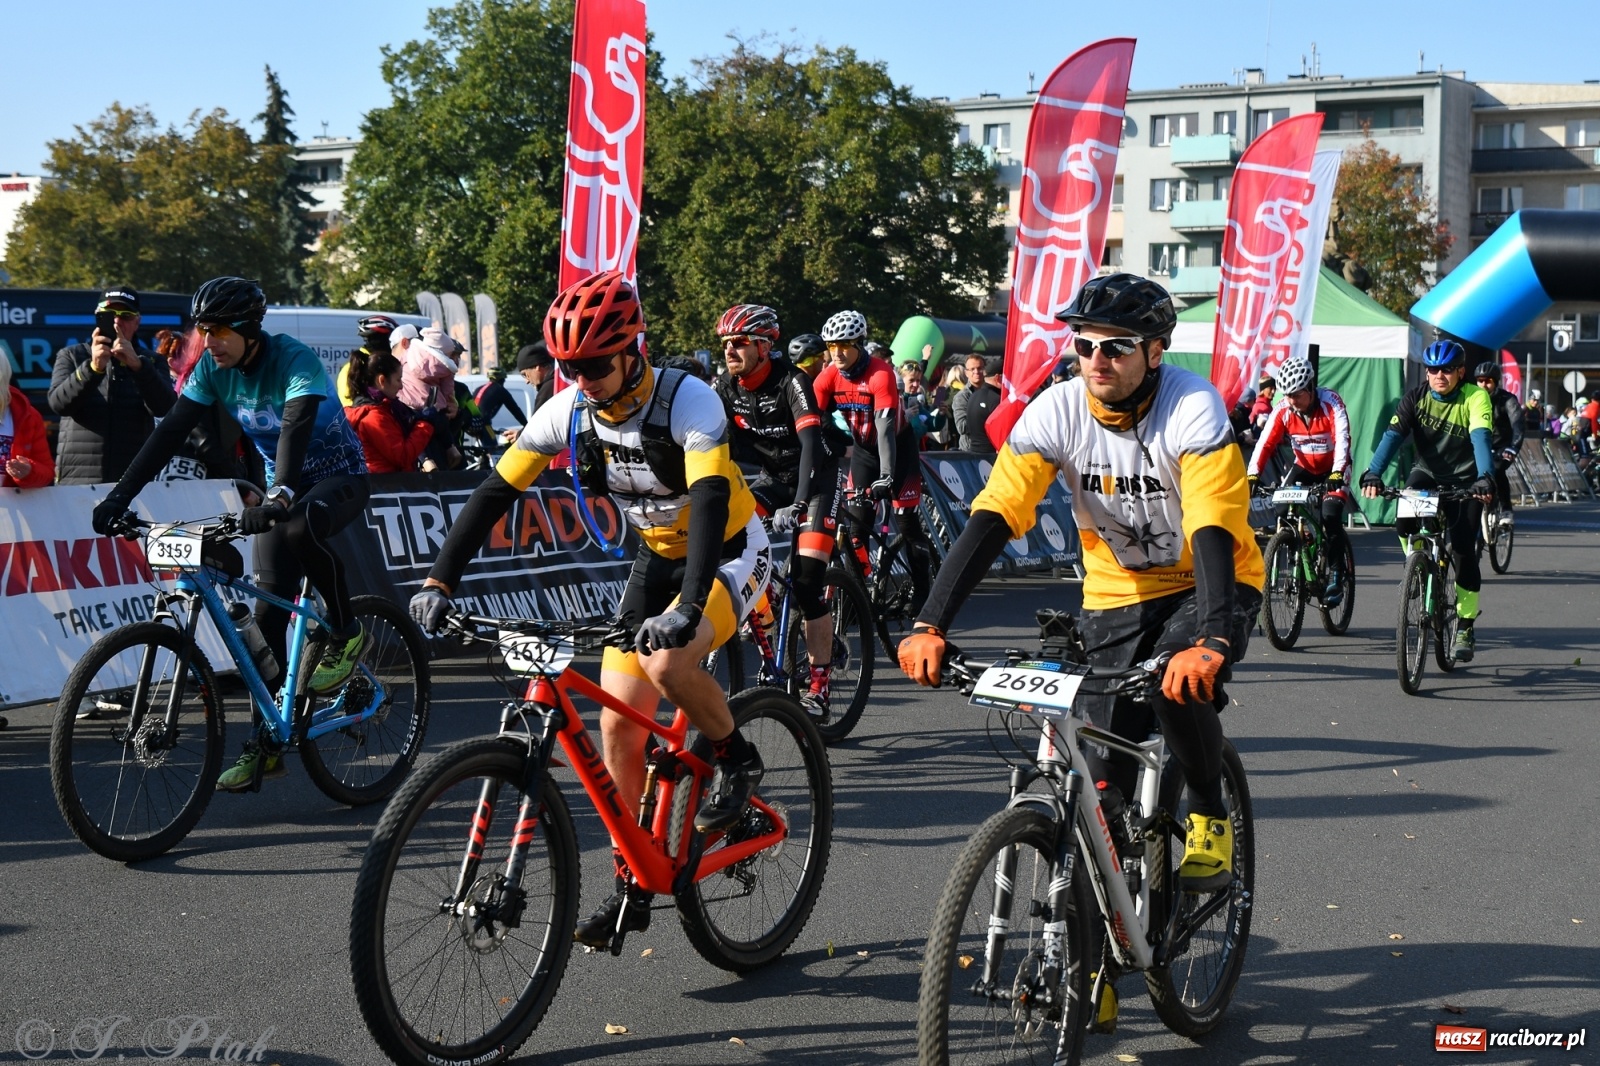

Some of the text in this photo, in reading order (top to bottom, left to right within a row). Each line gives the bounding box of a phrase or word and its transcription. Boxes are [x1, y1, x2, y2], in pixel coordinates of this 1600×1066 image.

[105, 290, 135, 301] HEAD
[1279, 491, 1303, 499] 3028
[371, 494, 617, 557] TRADO
[157, 542, 193, 559] 3159
[54, 600, 114, 639] TAKE
[992, 672, 1061, 696] 2696
[1050, 934, 1063, 969] FOX
